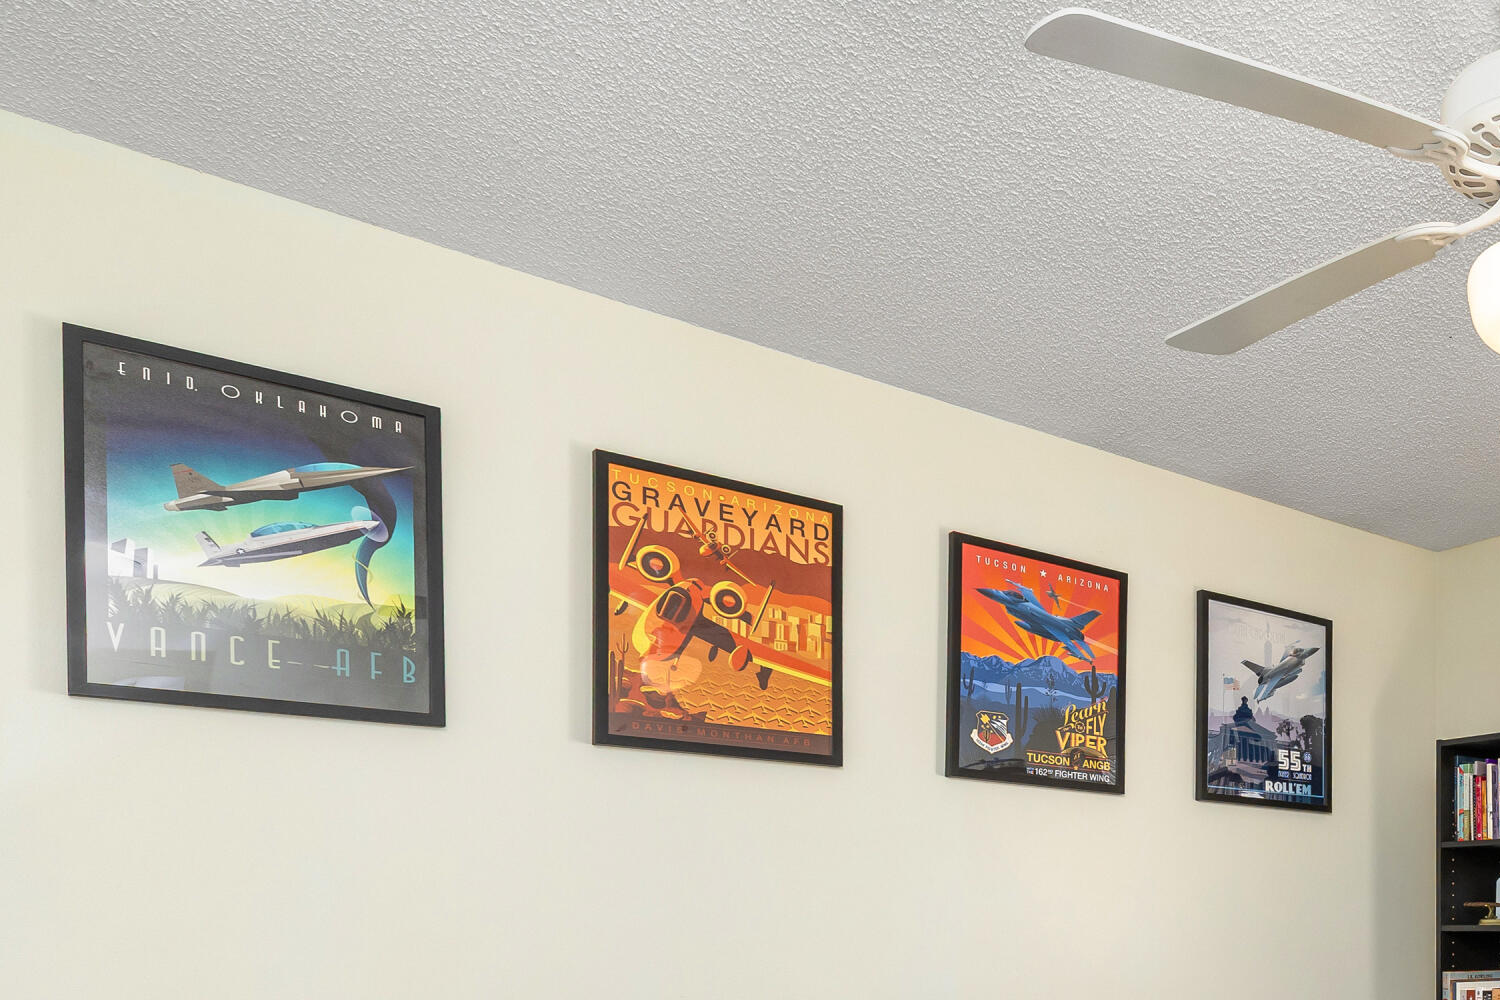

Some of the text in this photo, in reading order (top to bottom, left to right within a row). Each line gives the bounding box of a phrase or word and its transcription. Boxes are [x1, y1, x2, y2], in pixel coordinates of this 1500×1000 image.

[221, 384, 403, 434] OKLAHOMA
[611, 469, 830, 526] TUCSON ARIZONA
[611, 481, 830, 541] GRAVEYARD
[611, 502, 831, 567] GUARDIANS
[975, 554, 1110, 592] TUCSON ARIZONA
[105, 622, 416, 684] VANCE AFB
[631, 721, 683, 735] DAVIS
[696, 727, 776, 744] MONTHAN
[1063, 701, 1107, 725] Learn
[1086, 713, 1107, 736] FLY
[1056, 729, 1108, 758] VIPER
[1278, 749, 1301, 771] 55
[1026, 752, 1070, 766] TUCSON
[1082, 759, 1111, 771] ANGB
[1054, 769, 1088, 780] FIGHTER
[1089, 773, 1110, 783] WING
[1265, 780, 1312, 796] ROLL'EM
